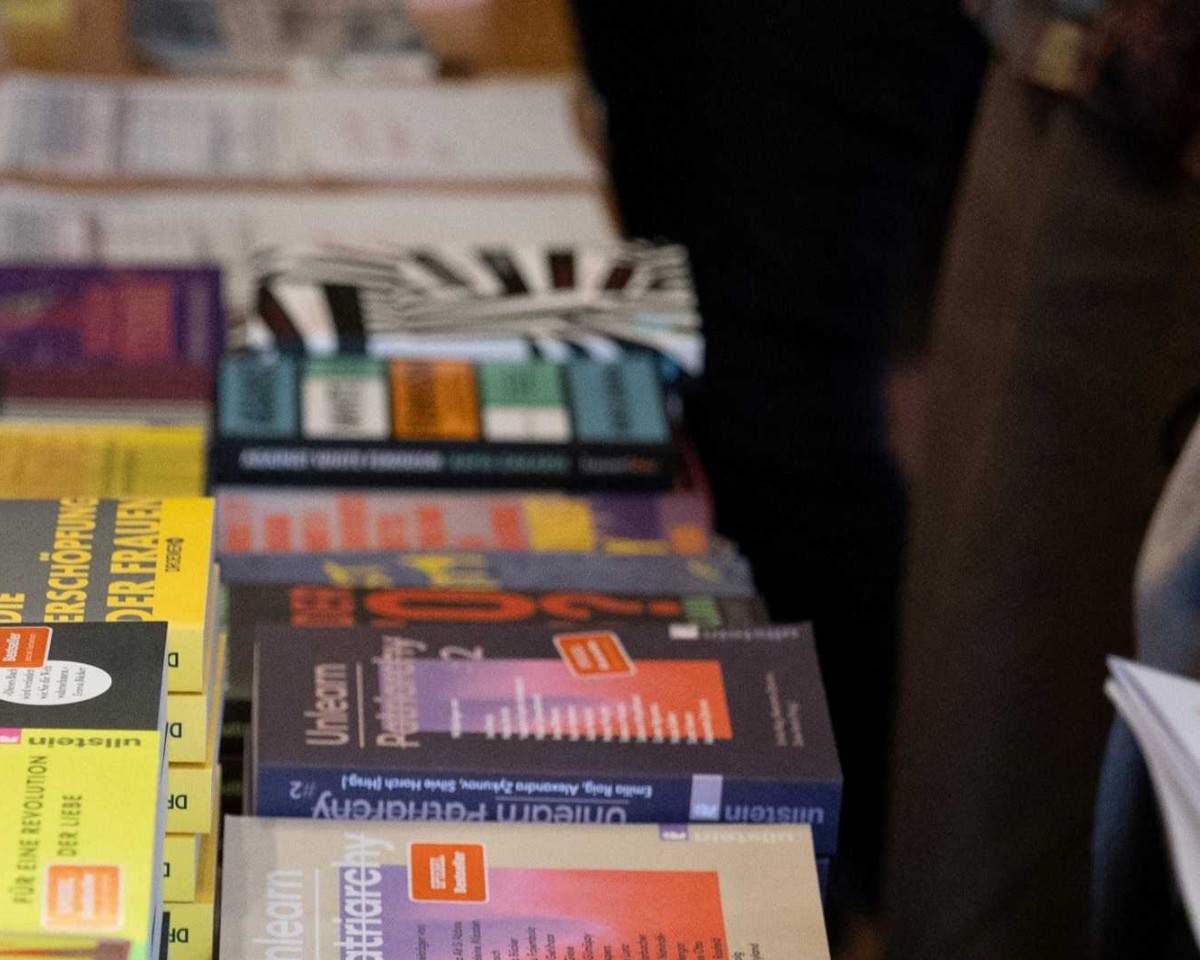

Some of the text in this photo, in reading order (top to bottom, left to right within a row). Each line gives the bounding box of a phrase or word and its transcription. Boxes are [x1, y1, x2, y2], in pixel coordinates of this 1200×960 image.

[105, 580, 155, 622] DER
[303, 662, 350, 746] Unlearn
[28, 735, 142, 748] ullstein
[384, 776, 422, 792] Horch
[423, 777, 457, 793] Silvie
[459, 777, 513, 795] Zykunov,
[515, 780, 580, 796] Alexandra
[582, 780, 613, 796] Roig,
[614, 783, 653, 798] Emilia
[61, 793, 83, 828] LIEBE
[11, 755, 49, 905] FÜR EINE REVOLUTION
[57, 829, 79, 858] DER
